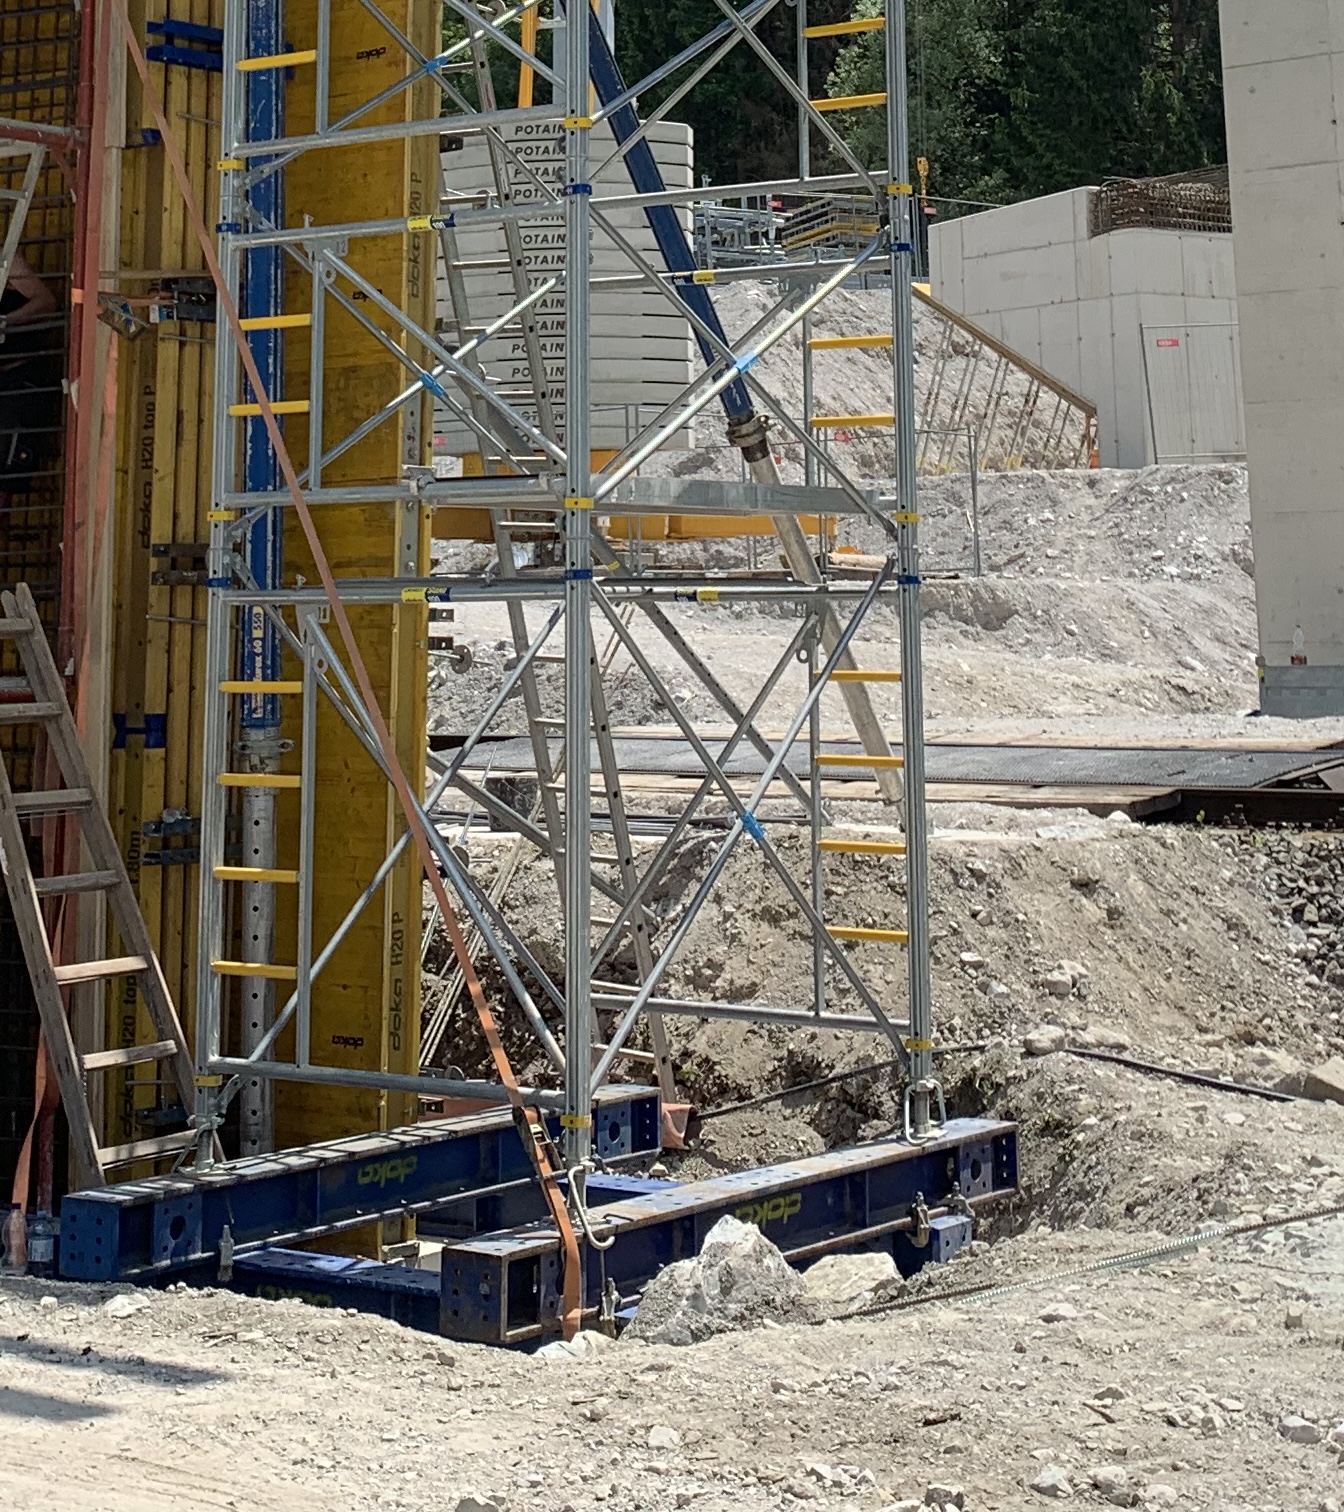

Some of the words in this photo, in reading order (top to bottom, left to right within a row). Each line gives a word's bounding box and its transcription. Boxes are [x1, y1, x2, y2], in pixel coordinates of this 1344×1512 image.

[356, 46, 387, 61] doka
[515, 124, 566, 136] POTAIN
[515, 145, 566, 157] POTAI
[411, 171, 422, 184] P
[522, 233, 566, 245] OTAIN
[408, 234, 421, 298] doka
[524, 254, 566, 266] OTAIN
[144, 384, 155, 396] P
[143, 400, 155, 429] top
[141, 435, 154, 470] H20
[139, 480, 152, 550] doka
[253, 612, 263, 631] 550
[253, 640, 263, 654] 60
[393, 911, 404, 926] P
[391, 928, 404, 966] H20
[387, 978, 403, 1052] doka
[332, 1034, 364, 1050] doka
[358, 1154, 418, 1188] doka
[735, 1192, 802, 1230] doka
